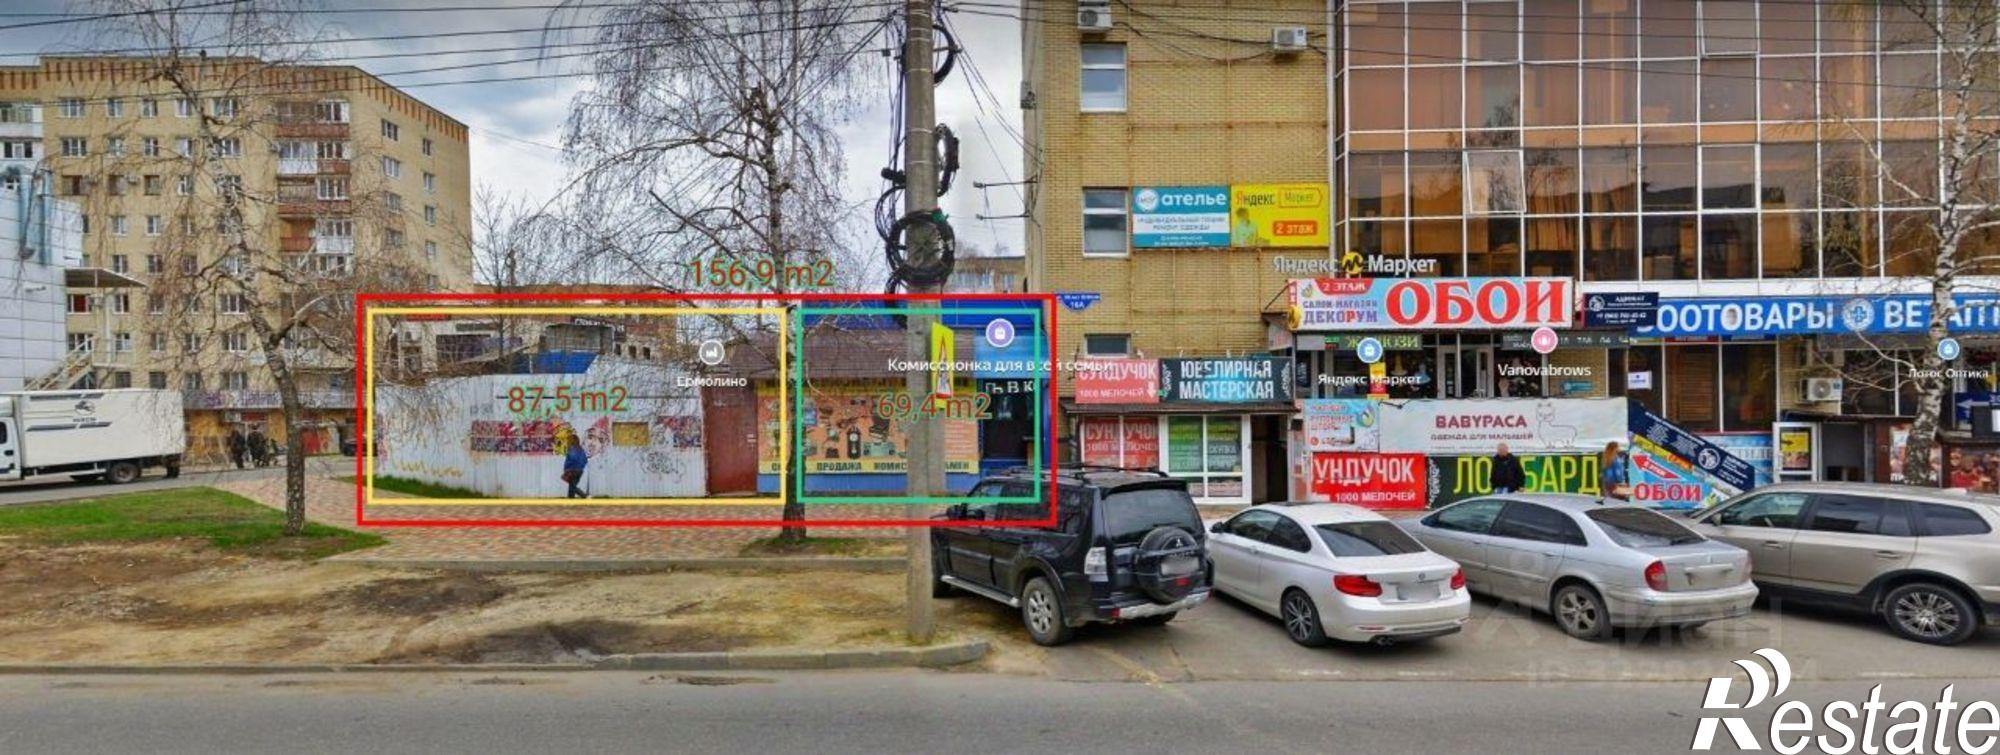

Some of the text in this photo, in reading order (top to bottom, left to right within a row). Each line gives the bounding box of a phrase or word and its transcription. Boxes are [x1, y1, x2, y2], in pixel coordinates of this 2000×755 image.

[1160, 192, 1226, 206] ателье
[1235, 192, 1275, 206] Яндекс
[1276, 223, 1284, 234] 2
[1273, 254, 1437, 276] Яндекс Маркет
[1322, 281, 1366, 292] 2 ЭТАЖ
[1386, 279, 1567, 327] ОБОИ
[1303, 310, 1378, 325] ДЕКОРУМ
[1637, 302, 1834, 333] ООТОВАРЫ
[1180, 360, 1273, 379] ЮВЕЛИРНАЯ
[1179, 380, 1275, 400] МАСТЕРСКАЯ
[816, 461, 862, 471] ПРОДАЖА
[1314, 457, 1416, 487] УНДУЧОК
[1453, 454, 1602, 494] ЛОБАРД
[1361, 489, 1417, 502] МЕЛОЧЕЙ
[1633, 483, 1701, 501] ОБОИ
